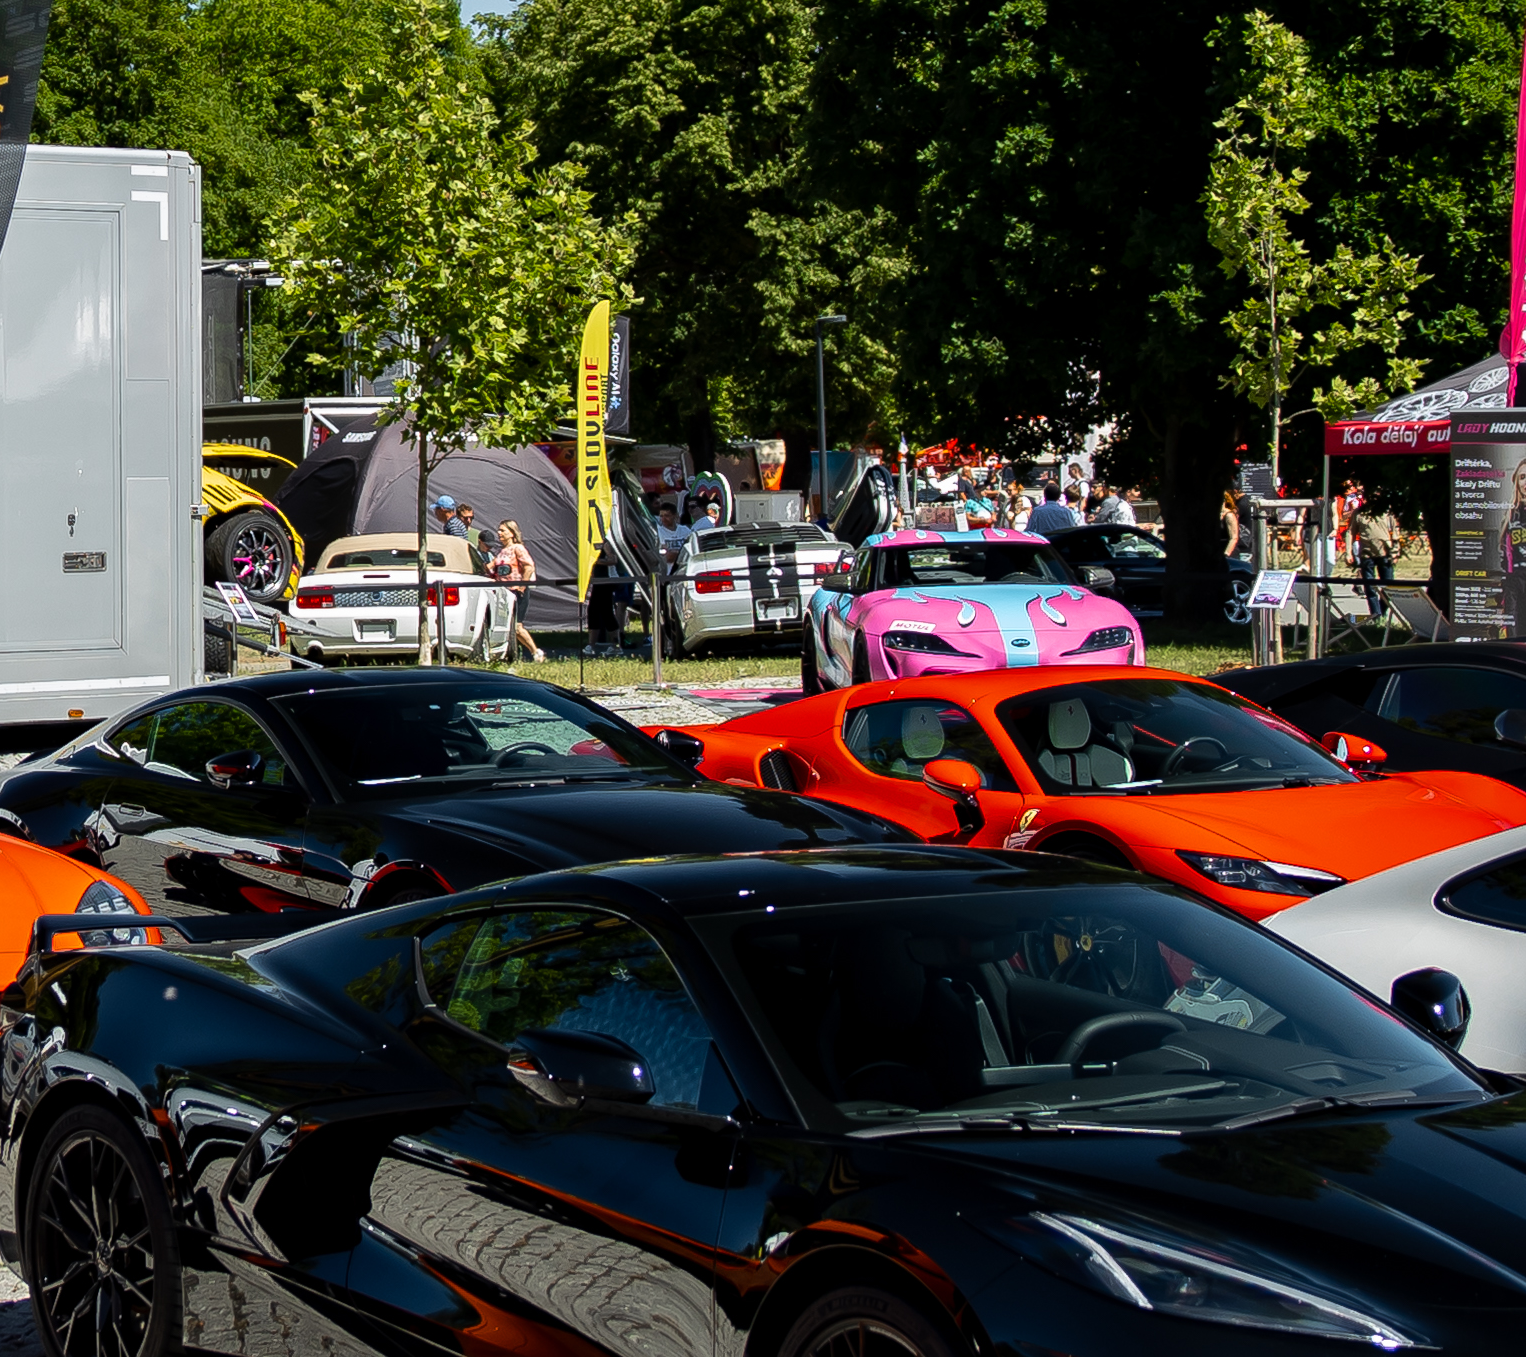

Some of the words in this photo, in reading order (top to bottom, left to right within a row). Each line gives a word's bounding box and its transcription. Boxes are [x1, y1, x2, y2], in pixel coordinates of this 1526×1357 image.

[610, 332, 621, 381] Galaxy
[610, 381, 621, 396] AI
[1343, 427, 1377, 445] Kola
[1457, 423, 1489, 434] LADY
[895, 622, 931, 632] MOTUL
